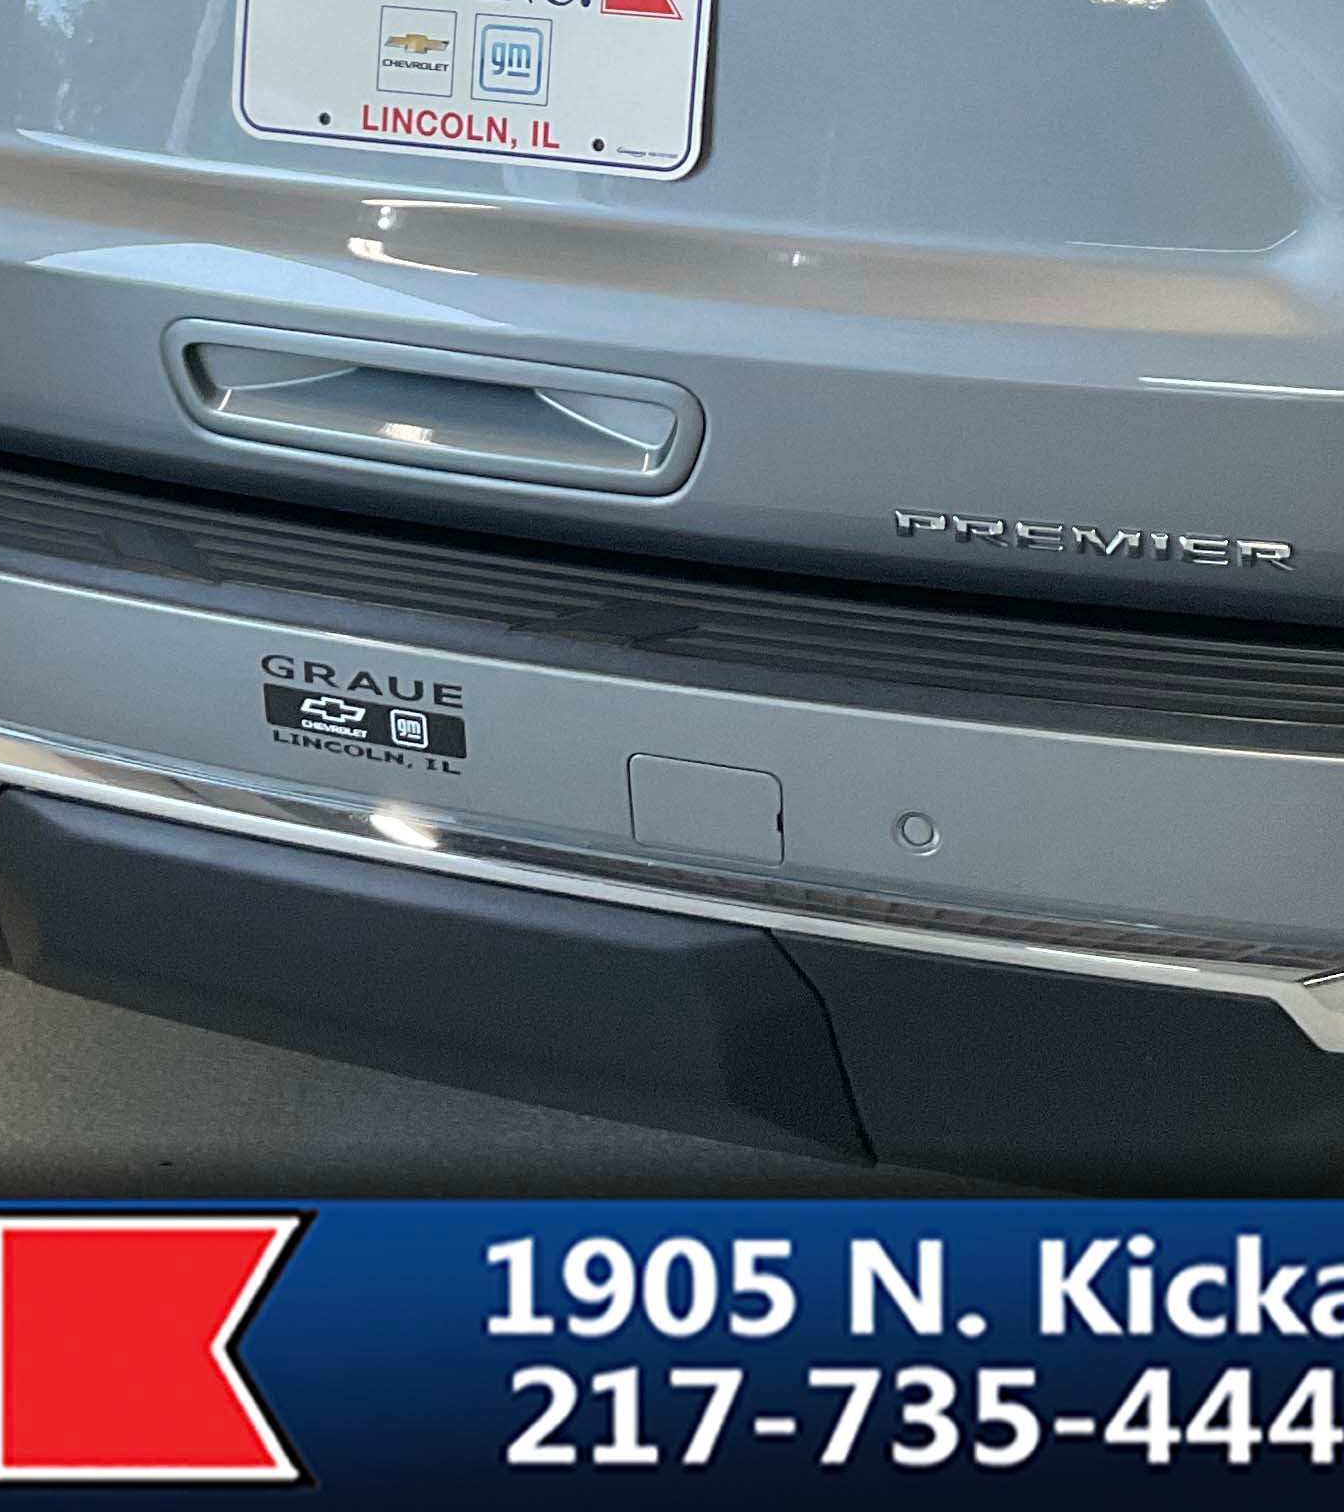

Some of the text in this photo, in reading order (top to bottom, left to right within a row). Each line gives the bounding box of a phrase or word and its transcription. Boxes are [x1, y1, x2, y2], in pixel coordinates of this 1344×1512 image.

[382, 58, 450, 72] CHEVROLET
[490, 40, 531, 78] gm
[361, 104, 561, 150] LINCOLN, IL
[895, 507, 1297, 571] PREMIER
[260, 653, 463, 709] GRAUE
[301, 718, 368, 739] CHEVROLET
[396, 717, 422, 740] gm
[272, 729, 462, 776] LINCOLN, IL
